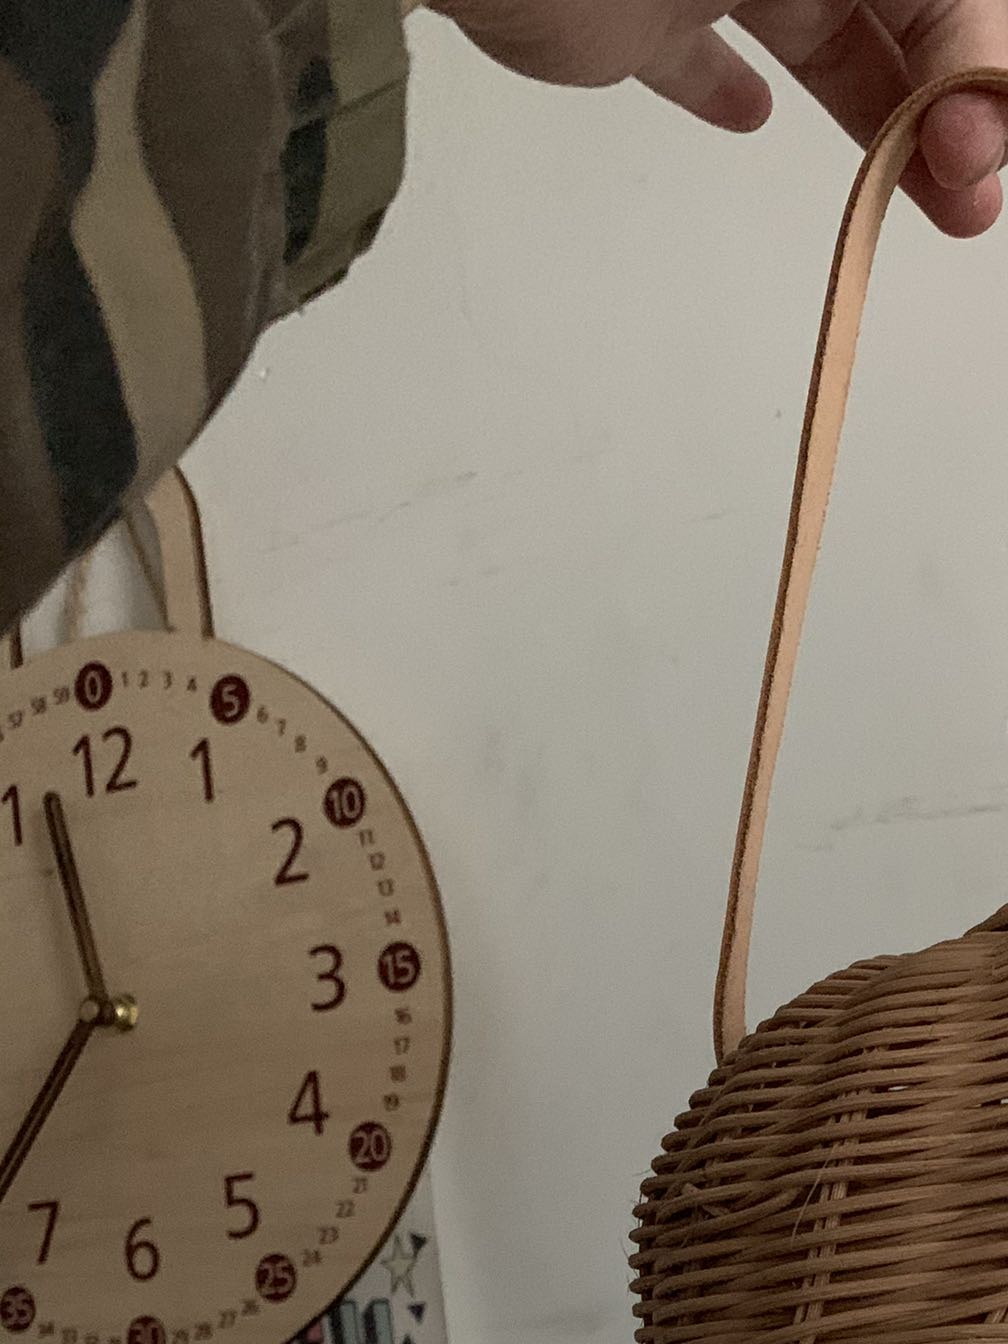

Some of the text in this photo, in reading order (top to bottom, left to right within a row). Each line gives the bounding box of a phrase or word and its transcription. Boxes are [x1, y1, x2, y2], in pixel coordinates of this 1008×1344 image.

[84, 673, 101, 702] 0
[138, 669, 149, 689] 2
[163, 670, 173, 690] 3
[220, 682, 241, 718] 5
[73, 727, 137, 797] 12
[191, 738, 214, 802] 1
[328, 783, 363, 818] 10
[272, 818, 309, 886] 2
[309, 944, 346, 1012] 3
[384, 949, 413, 983] 15
[288, 1071, 329, 1135] 4
[355, 1131, 385, 1164] 20
[224, 1173, 259, 1239] 5
[335, 1199, 356, 1219] 22
[28, 1201, 59, 1264] 7
[125, 1218, 160, 1282] 6
[259, 1262, 294, 1295] 25
[2, 1293, 34, 1325] 35
